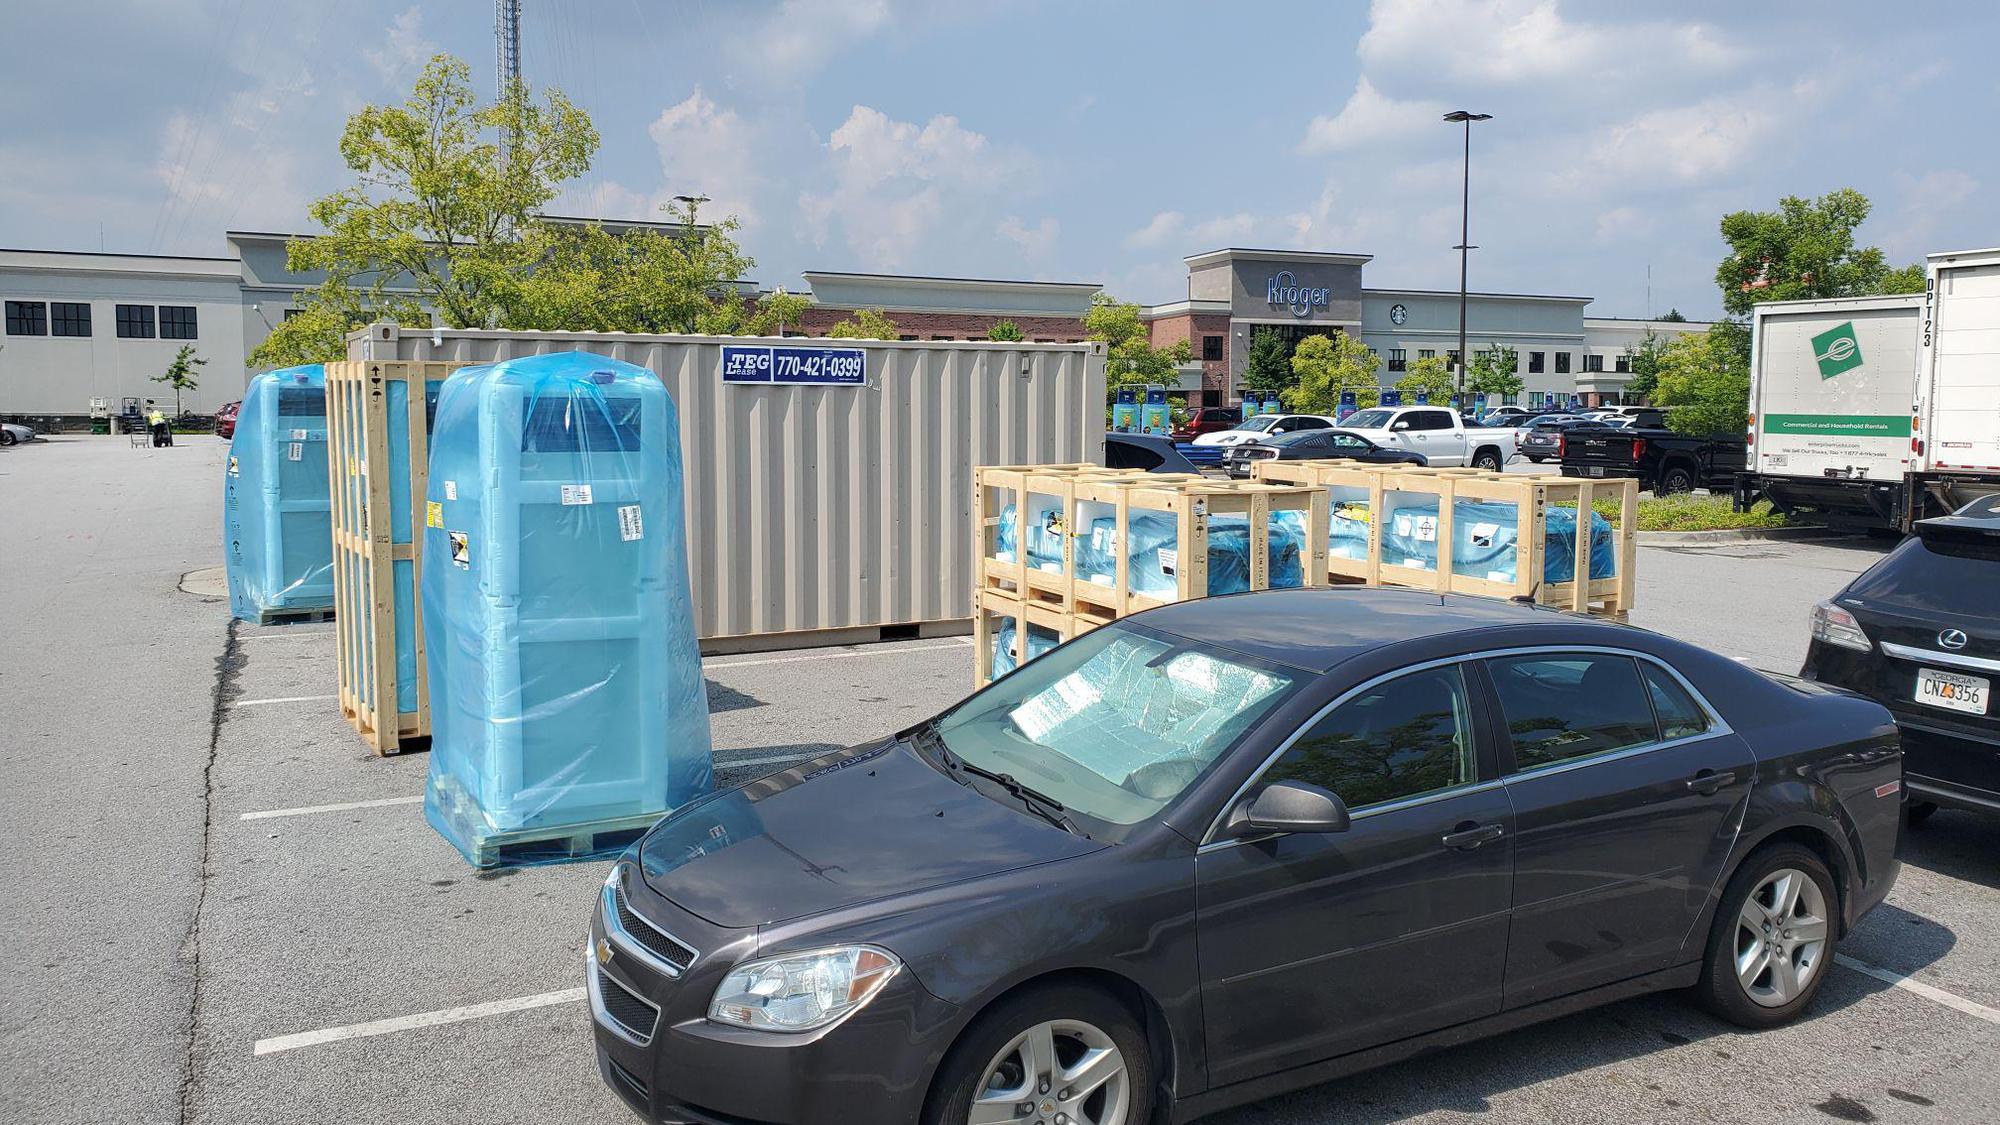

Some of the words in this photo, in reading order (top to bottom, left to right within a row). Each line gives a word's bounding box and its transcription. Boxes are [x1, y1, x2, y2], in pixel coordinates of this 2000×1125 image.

[1267, 270, 1330, 317] Kroger
[725, 362, 757, 376] Lease
[731, 354, 770, 370] TEG
[777, 356, 861, 377] 770-421-0399
[1934, 672, 1973, 684] GEORGIA
[1924, 678, 1980, 703] CNZ3356
